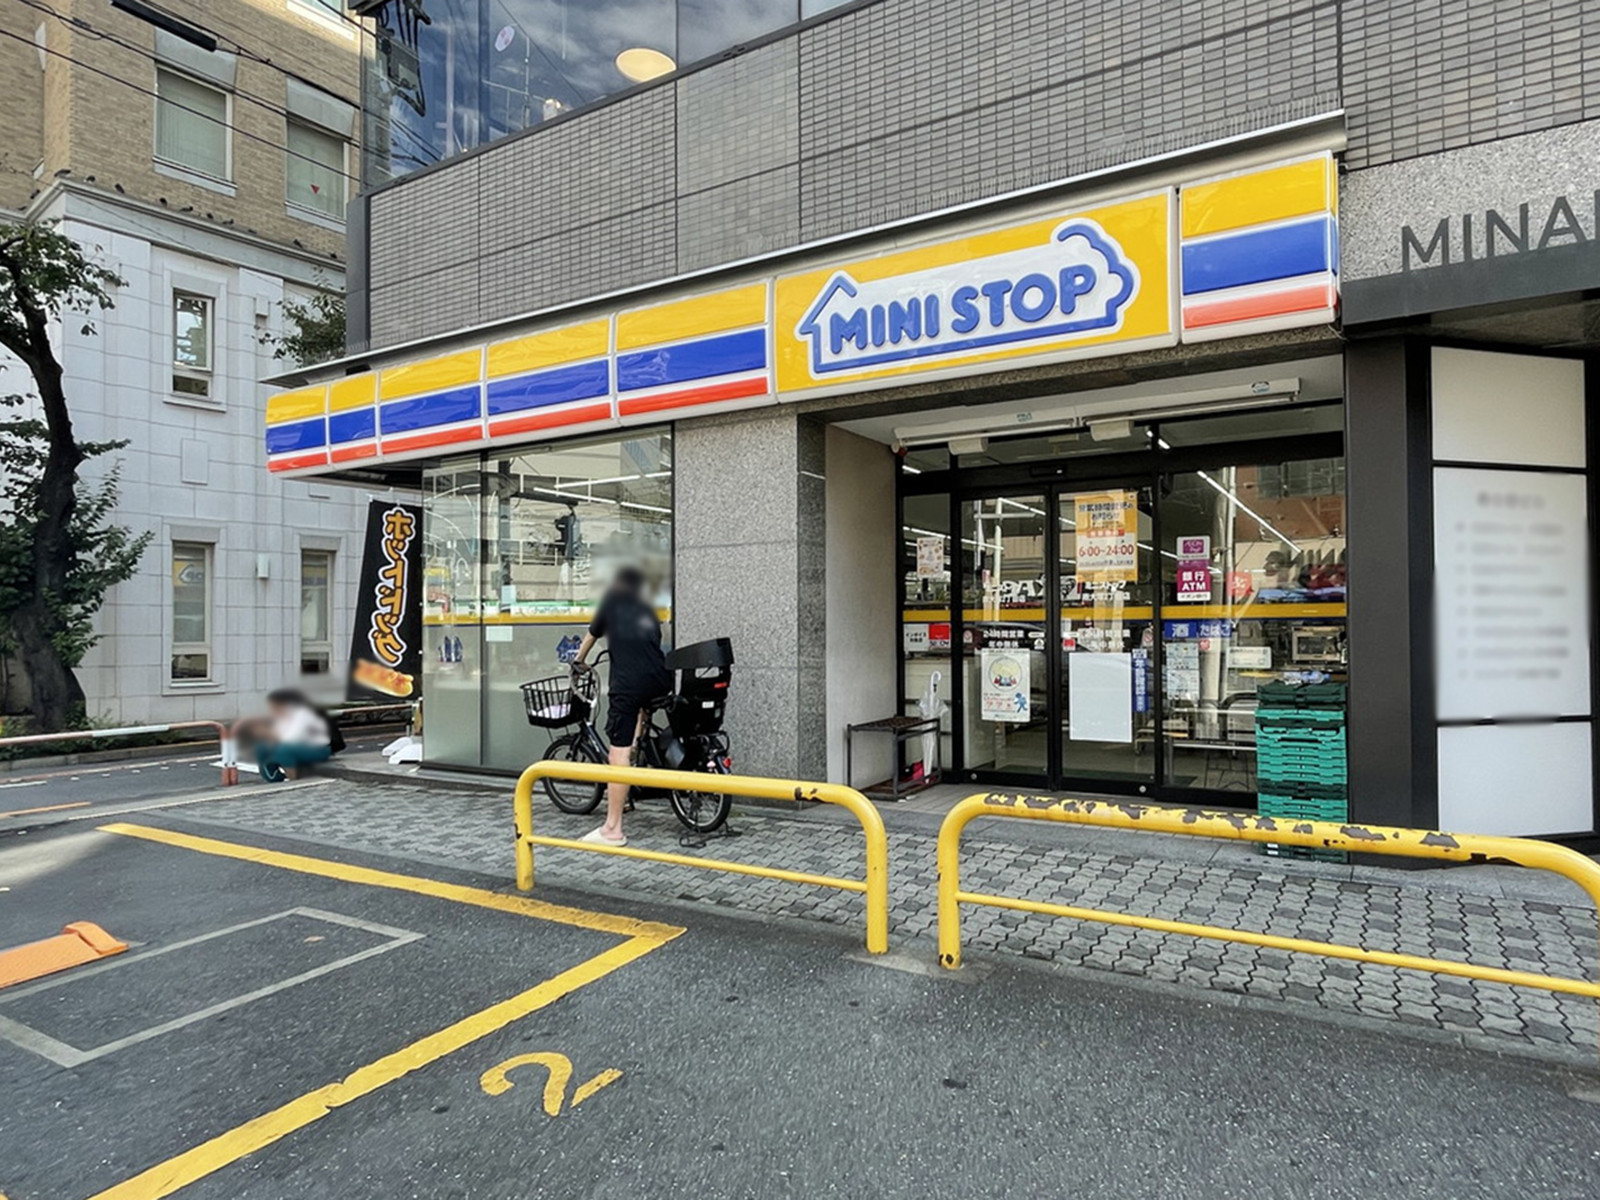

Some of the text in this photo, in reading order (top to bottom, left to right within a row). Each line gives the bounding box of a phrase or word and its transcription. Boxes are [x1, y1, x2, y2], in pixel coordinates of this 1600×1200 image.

[1402, 189, 1600, 272] MINA
[830, 264, 1097, 355] MINI STOP
[369, 507, 415, 666] ホットドッグ
[1182, 571, 1205, 582] 銀行
[1182, 582, 1206, 591] ATM
[1172, 623, 1189, 637] 酒
[1200, 623, 1231, 637] たばこ
[479, 1051, 624, 1117] 2
